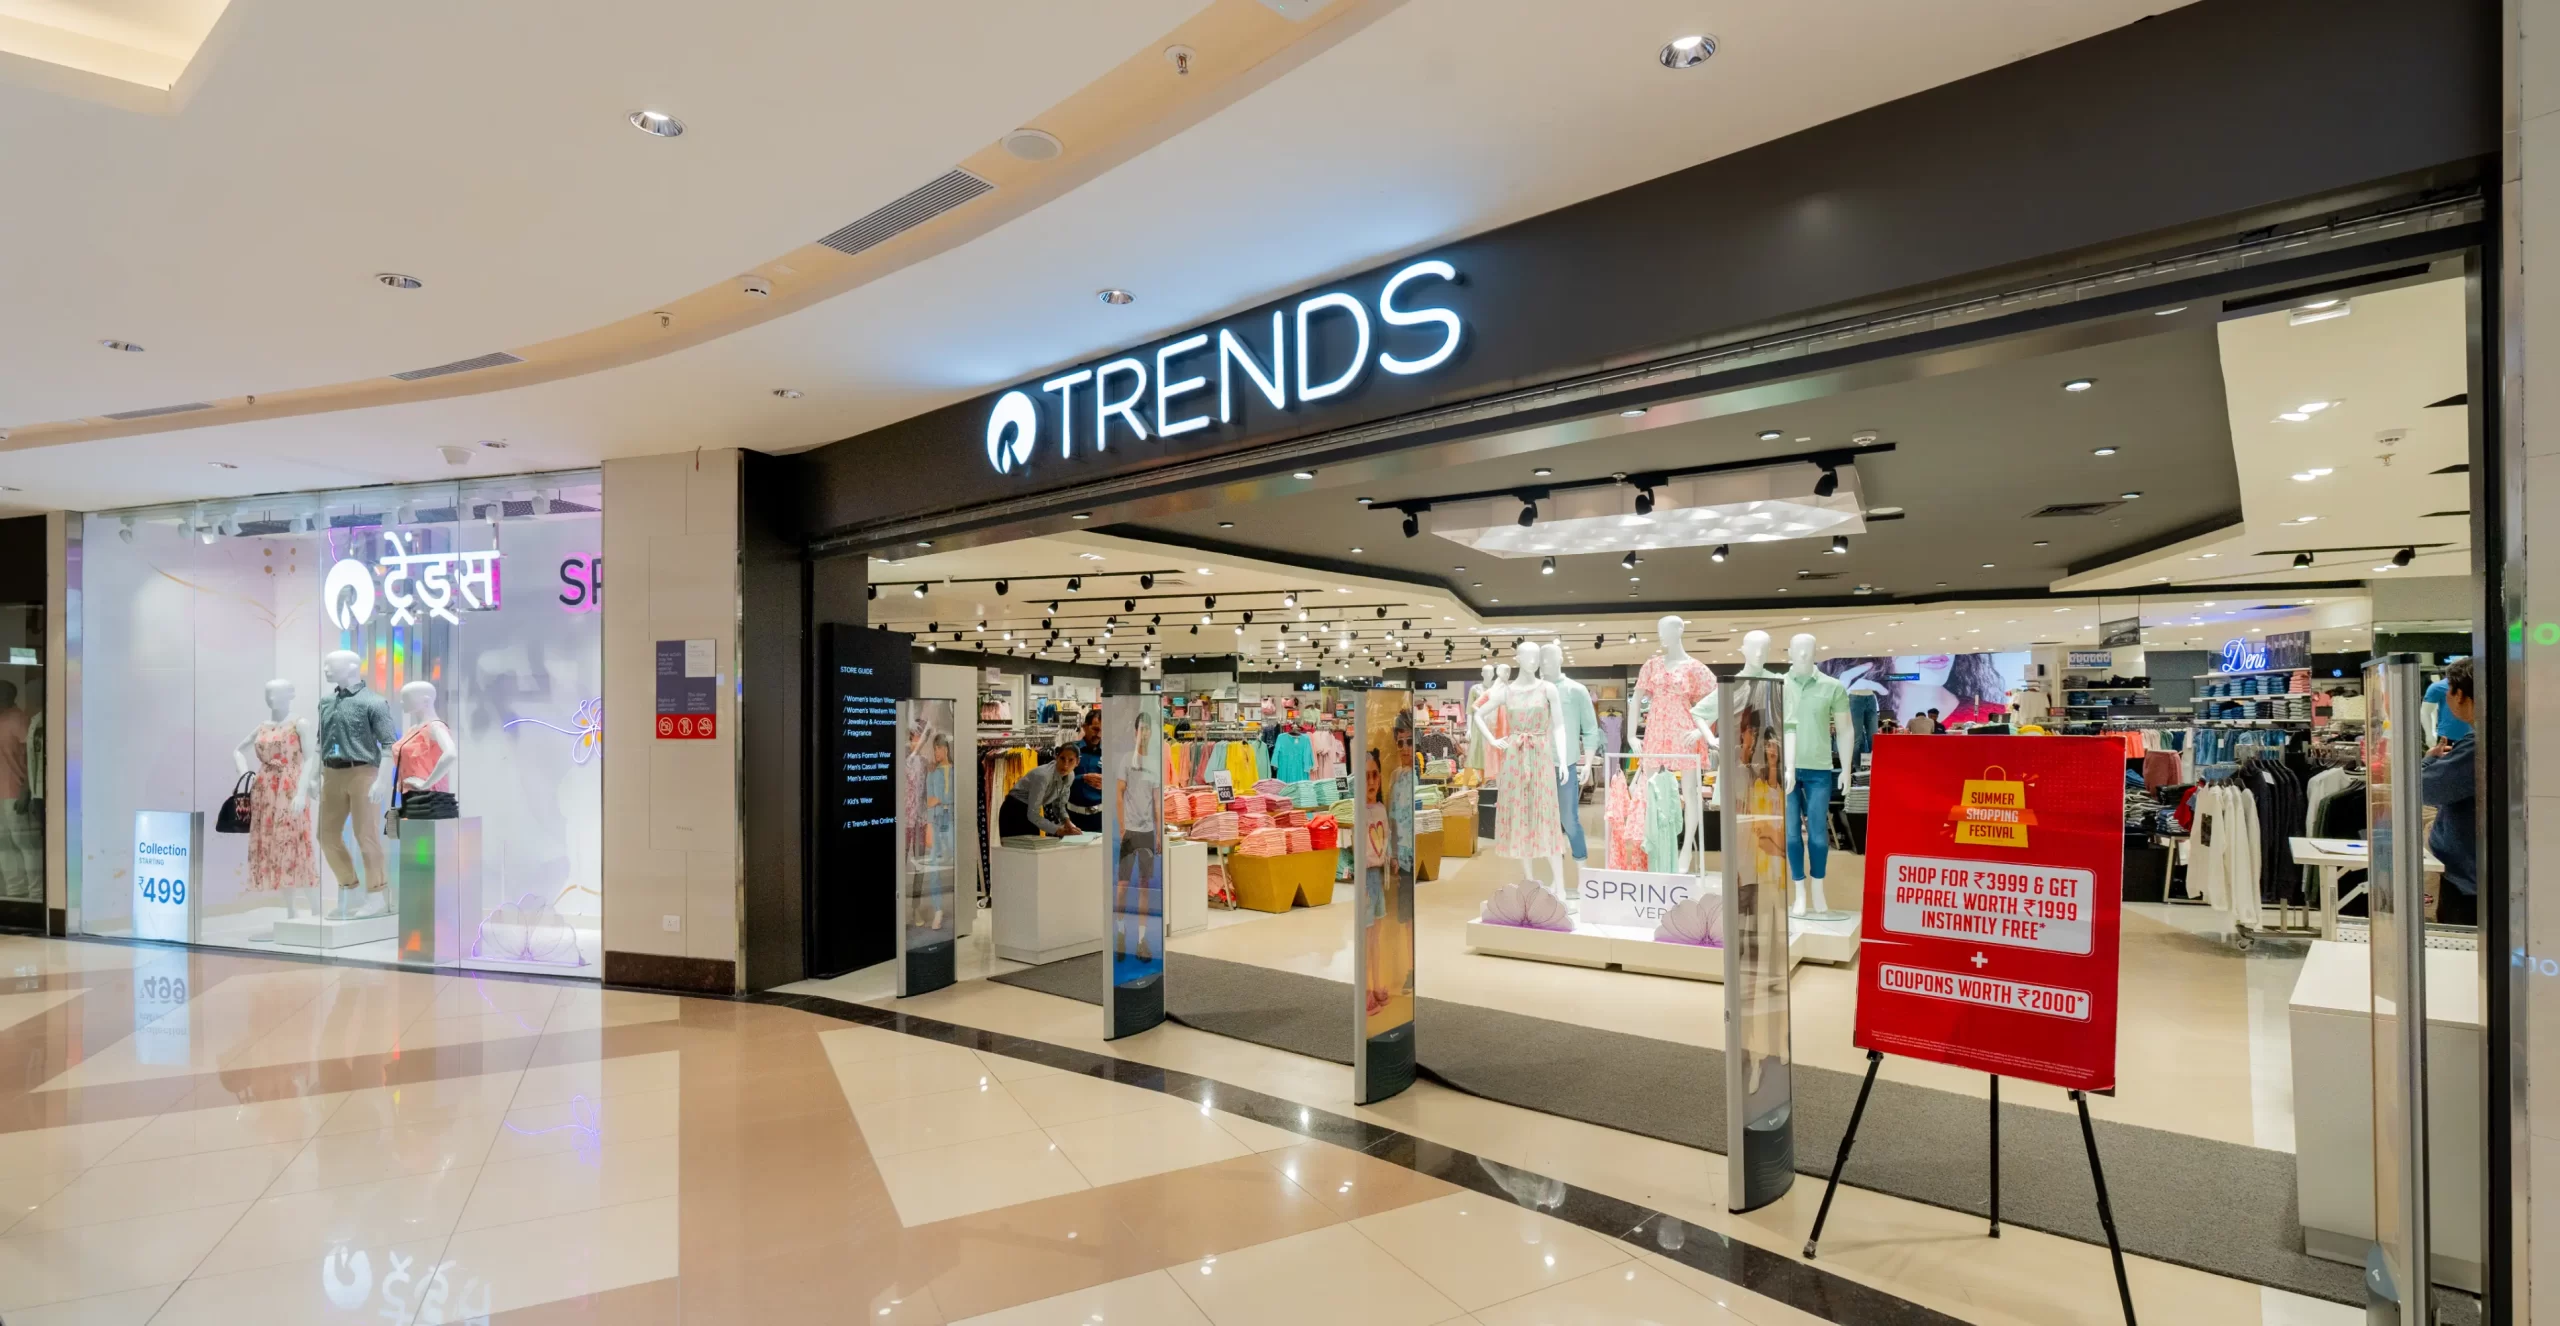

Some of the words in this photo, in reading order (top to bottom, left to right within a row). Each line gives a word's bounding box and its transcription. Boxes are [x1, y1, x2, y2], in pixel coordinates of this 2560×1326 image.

[1043, 260, 1461, 459] TRENDS
[380, 531, 500, 626] ट्रेंड्स
[858, 667, 873, 675] GUIDE
[1971, 792, 2014, 805] SUMMER
[1966, 807, 2019, 822] SHOPPING
[1969, 825, 2014, 839] FESTIVAL
[139, 842, 187, 856] Collection
[138, 876, 186, 905] ₹499
[1585, 880, 1688, 905] SPRING
[1898, 866, 1936, 886] SHOP
[1941, 869, 1968, 887] FOR
[1973, 871, 2028, 893] ₹3999
[2034, 876, 2044, 895] &
[2050, 878, 2078, 898] GET
[1896, 887, 1958, 909] APPAREL
[1964, 892, 2018, 915] WORTH
[2024, 899, 2077, 921] ₹1999
[1922, 910, 1997, 935] INSTANTLY
[1886, 969, 1953, 994] COUPONS
[1958, 978, 2012, 1004] WORTH
